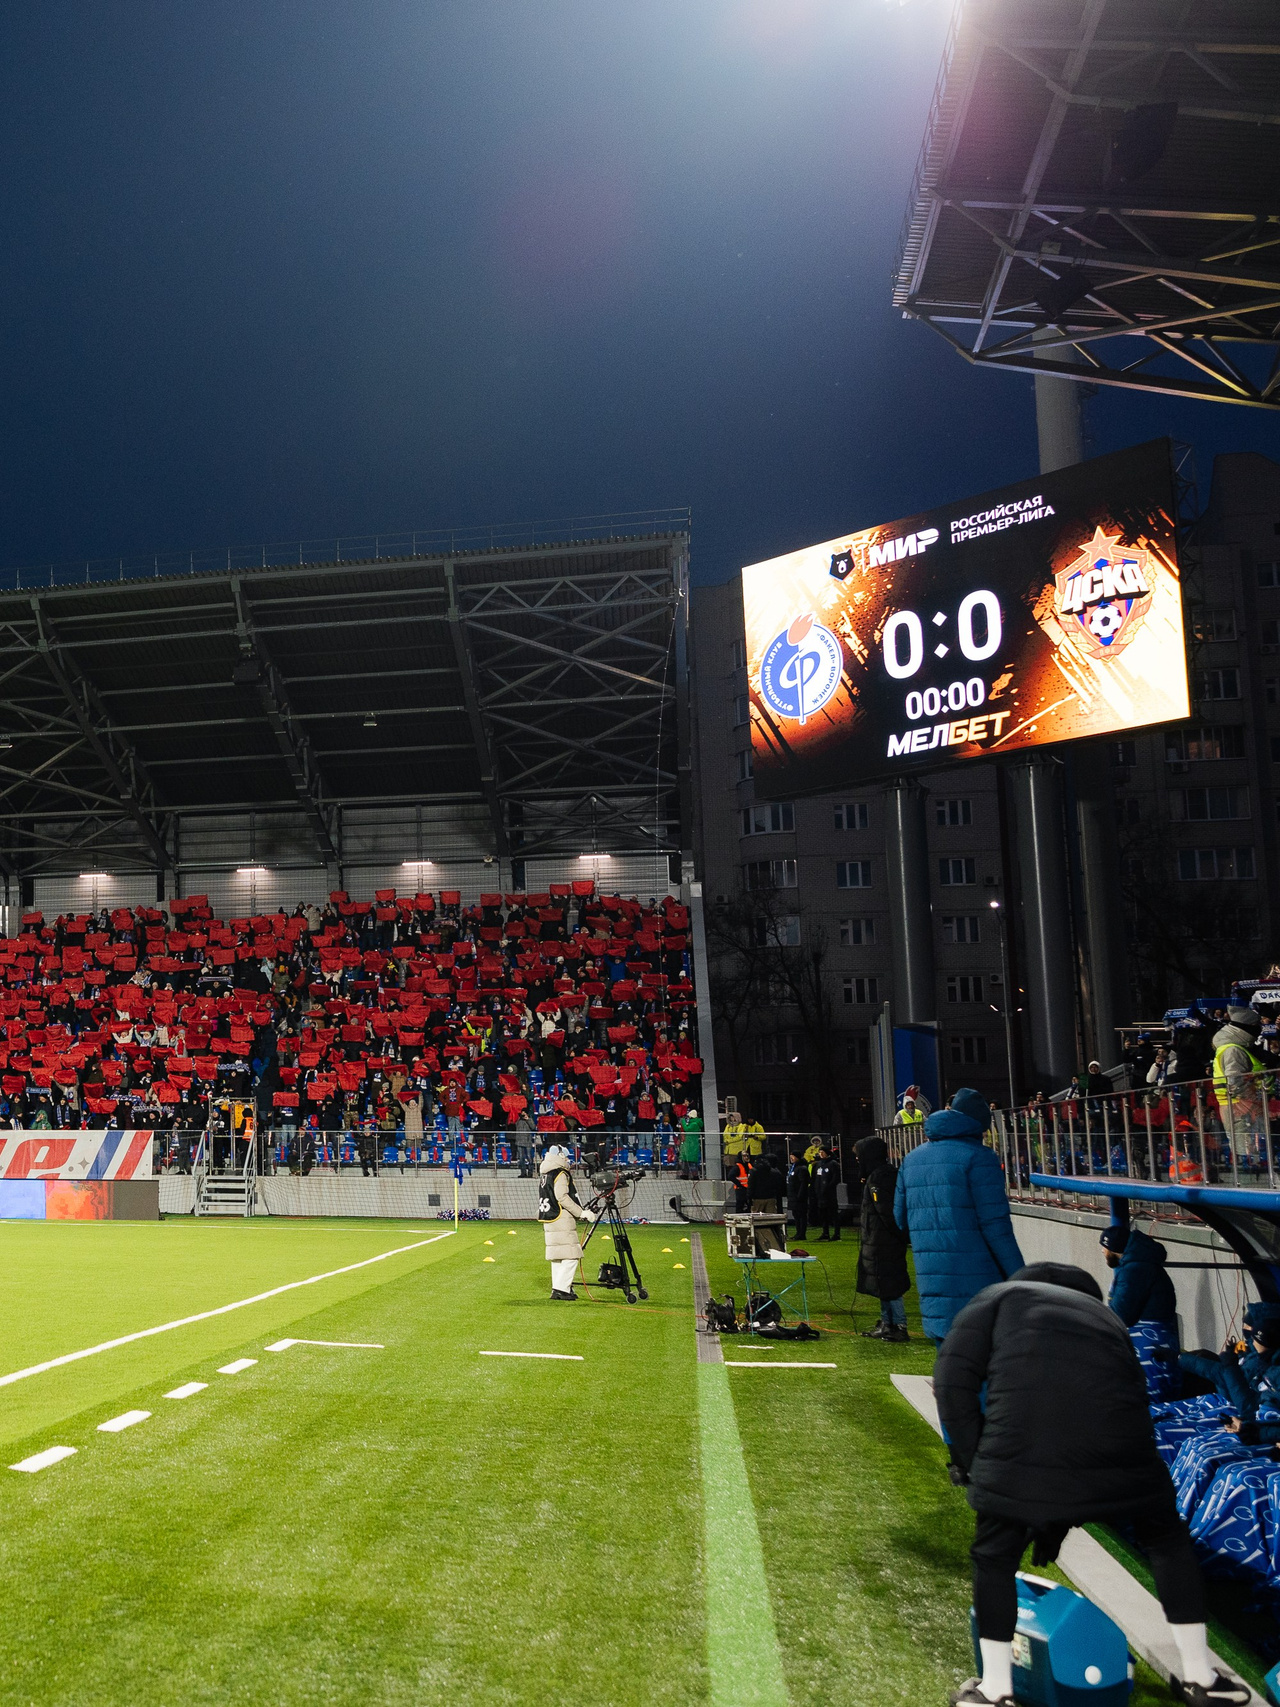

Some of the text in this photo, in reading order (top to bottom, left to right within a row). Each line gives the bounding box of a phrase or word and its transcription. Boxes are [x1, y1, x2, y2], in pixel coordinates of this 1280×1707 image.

[950, 495, 1043, 531] РОССИЙСКАЯ
[951, 505, 1055, 544] ПРЕМЬЕР-ЛИГА
[870, 528, 939, 568] МИР
[1061, 563, 1149, 613] ЦСКА
[767, 642, 782, 664] КЛУБ
[882, 589, 1002, 679] 0:0
[905, 677, 985, 720] 00:00
[887, 710, 1011, 758] МЕЛБЕТ
